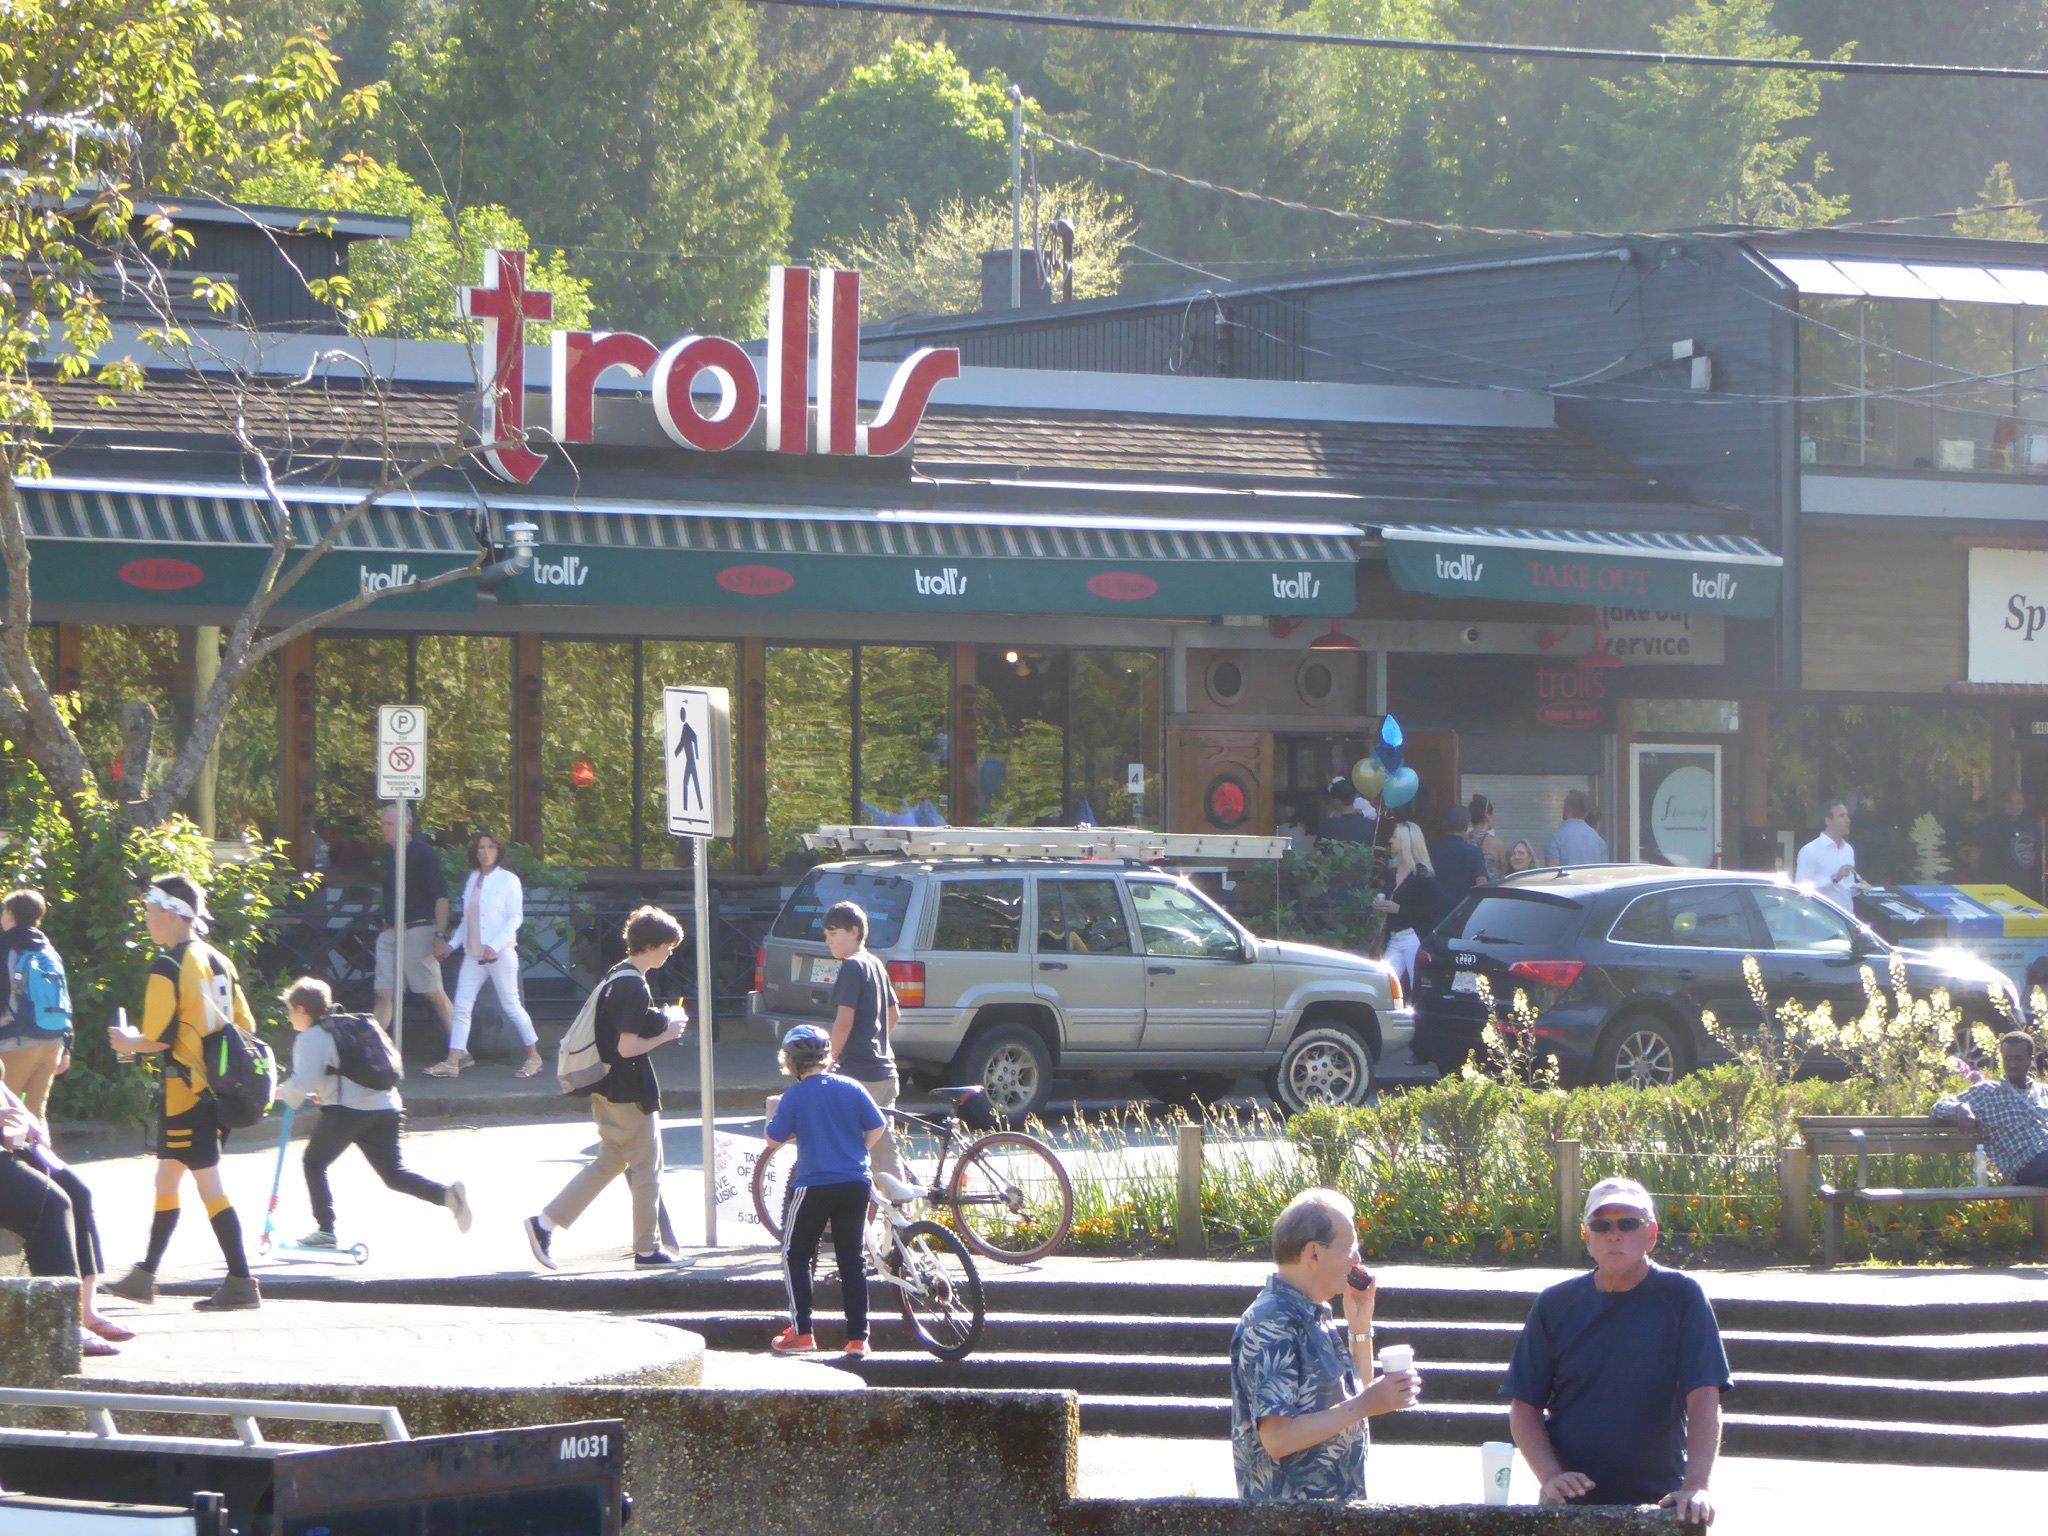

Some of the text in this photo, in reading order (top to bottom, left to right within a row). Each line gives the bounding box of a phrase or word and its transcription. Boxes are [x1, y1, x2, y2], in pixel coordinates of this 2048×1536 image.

[457, 248, 960, 485] trolls
[533, 556, 589, 586] troll's
[1436, 554, 1483, 581] troll's
[1530, 562, 1650, 594] TAKE OUT
[915, 568, 967, 595] troll's
[1272, 572, 1320, 598] troll's
[1693, 573, 1737, 600] troll's
[737, 1166, 751, 1178] OF
[744, 1152, 776, 1167] TASE
[714, 1176, 730, 1191] IVE
[738, 1212, 760, 1224] 5:30
[561, 1434, 608, 1460] M031
